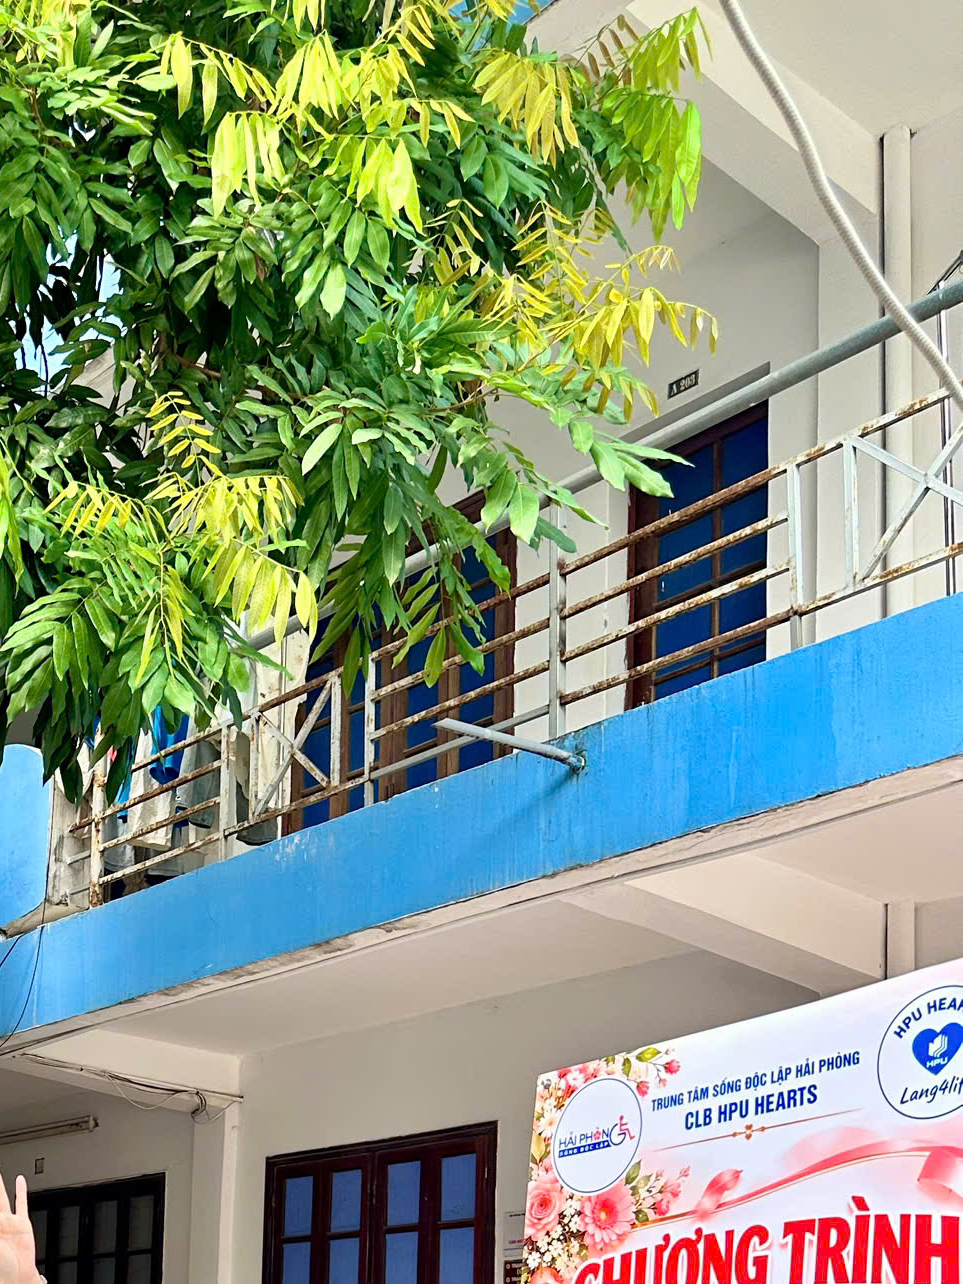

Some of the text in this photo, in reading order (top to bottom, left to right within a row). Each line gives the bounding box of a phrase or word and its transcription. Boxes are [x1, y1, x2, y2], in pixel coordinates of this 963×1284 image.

[670, 383, 677, 396] A
[894, 1008, 923, 1039] HPU
[926, 1056, 948, 1068] HPU
[651, 1051, 860, 1112] TRUNG TÂM SỐNG ĐỘC LẬP HẢI PHÒNG
[685, 1084, 818, 1130] CLB HPU HEARTS
